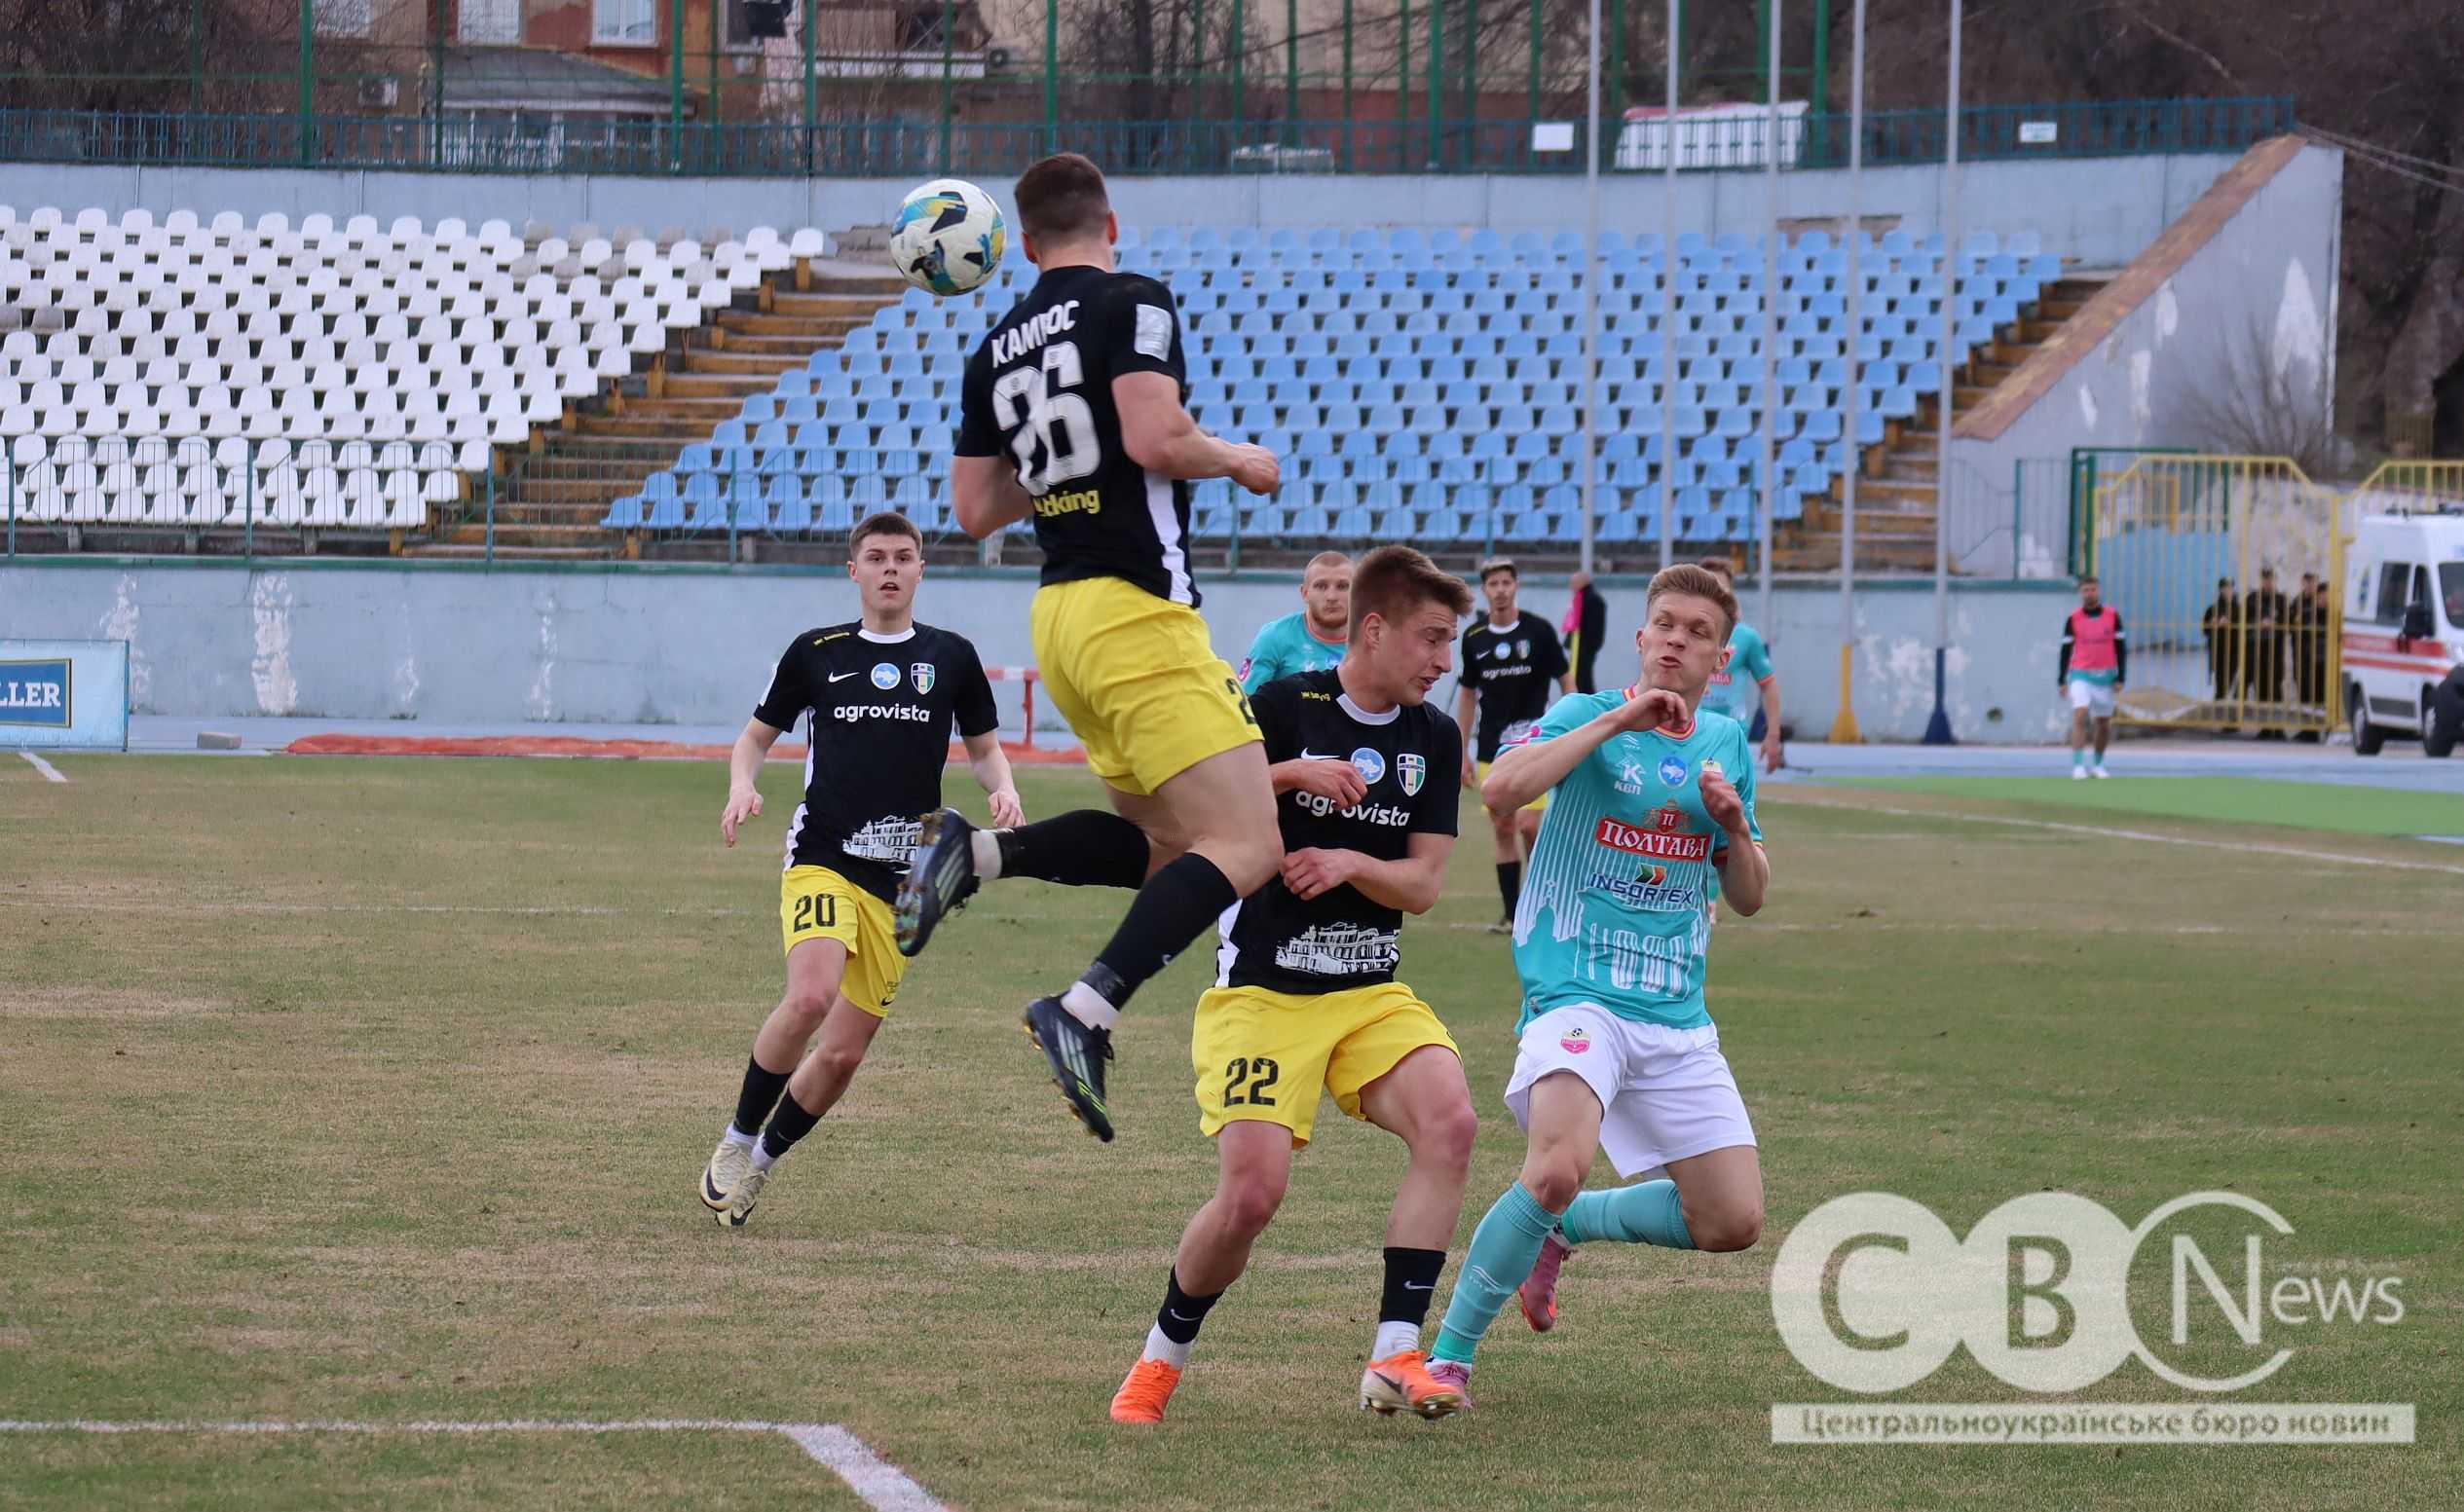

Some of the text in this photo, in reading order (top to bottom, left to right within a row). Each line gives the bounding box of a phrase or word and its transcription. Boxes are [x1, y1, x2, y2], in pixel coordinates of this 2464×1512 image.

[992, 341, 1101, 497] 26
[834, 703, 930, 722] agrovista
[1601, 820, 1707, 858] ПОЛТАВА
[1589, 873, 1696, 904] INSORTEX
[794, 893, 836, 933] 20
[1224, 1057, 1279, 1108] 22
